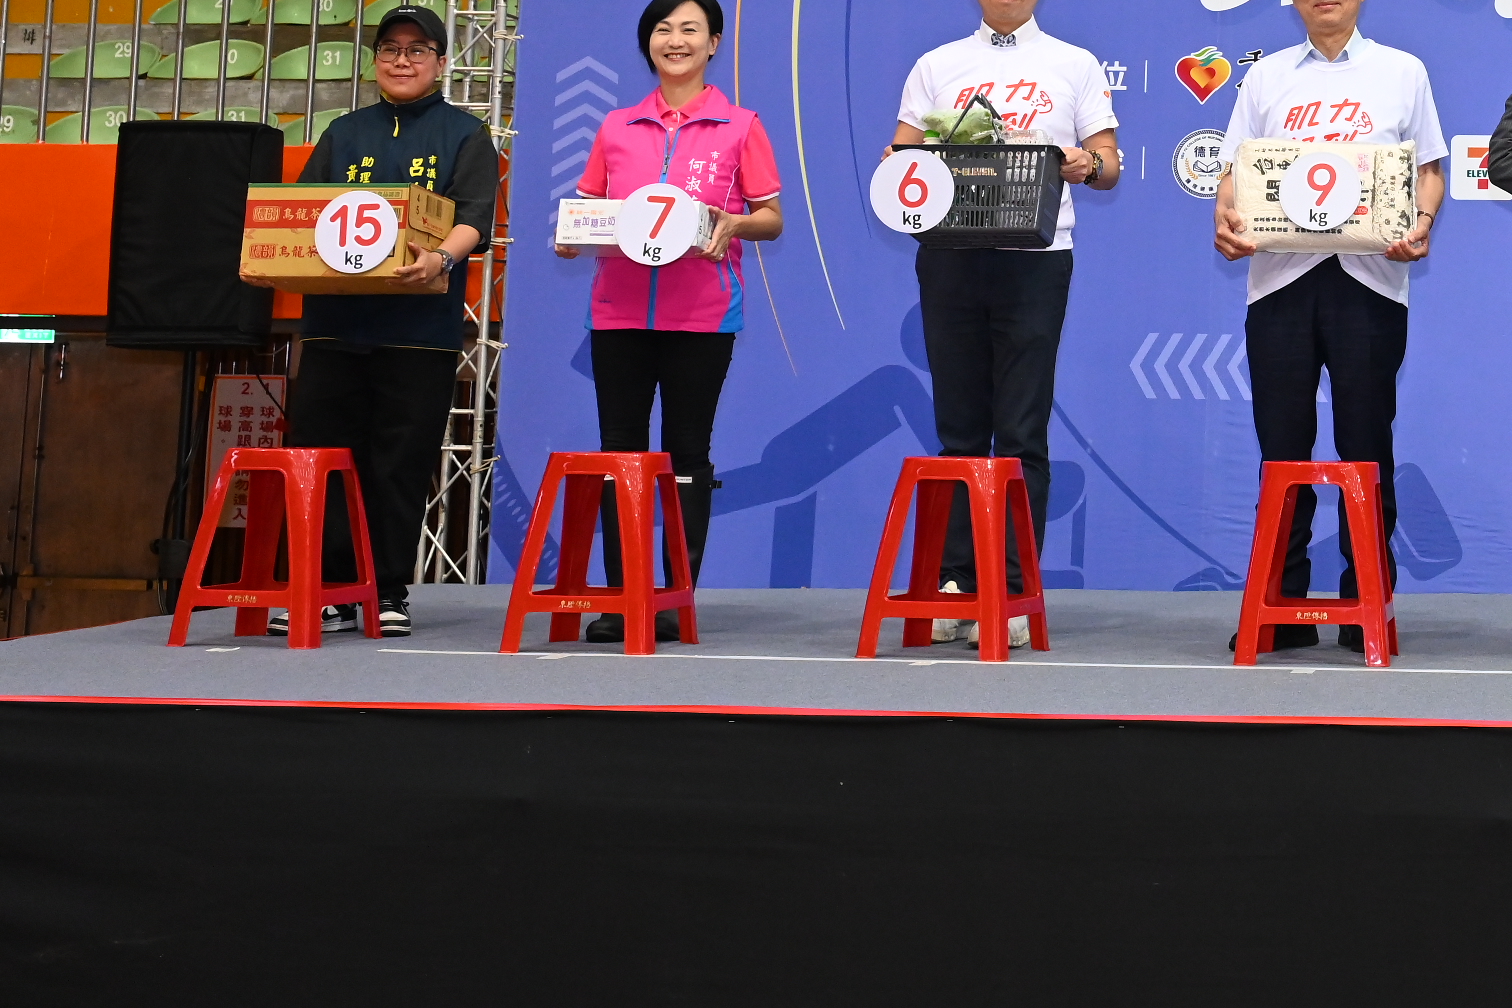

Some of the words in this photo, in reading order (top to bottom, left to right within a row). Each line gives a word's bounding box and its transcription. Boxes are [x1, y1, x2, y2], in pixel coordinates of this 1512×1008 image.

[115, 43, 132, 58] 29
[323, 50, 340, 65] 31
[954, 79, 1038, 109] 肌力
[104, 112, 126, 127] 30
[1283, 98, 1361, 131] 肌力
[1194, 145, 1220, 158] 德育
[346, 165, 358, 182] 黃
[360, 156, 375, 183] 助理
[409, 158, 425, 177] 呂
[426, 155, 438, 192] 市議員
[707, 151, 721, 185] 市議員
[685, 158, 706, 201] 何淑
[898, 161, 928, 208] 6
[1307, 163, 1337, 206] 9
[282, 207, 321, 221] 烏龍茶
[573, 216, 616, 229] 無加糖豆奶
[647, 195, 676, 239] 7
[903, 211, 922, 228] kg
[1309, 209, 1328, 226] kg
[330, 203, 382, 247] 15
[278, 245, 319, 258] 烏龍茶
[345, 251, 364, 269] kg
[642, 243, 662, 261] kg
